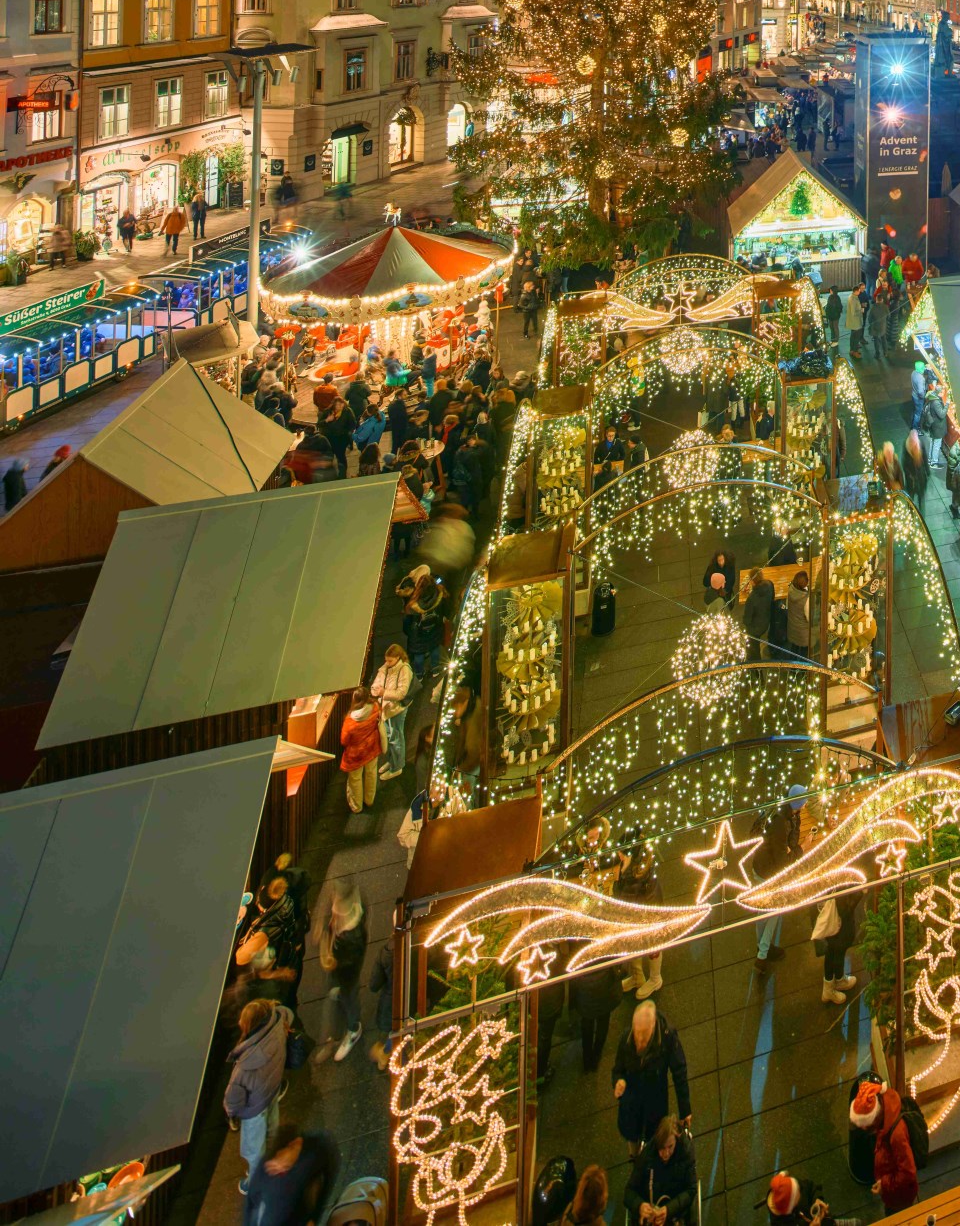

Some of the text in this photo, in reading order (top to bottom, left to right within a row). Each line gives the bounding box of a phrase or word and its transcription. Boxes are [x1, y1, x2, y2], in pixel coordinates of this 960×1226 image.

[880, 136, 918, 145] Advent
[880, 147, 917, 156] in Graz
[4, 289, 86, 325] Süßer Steirer
